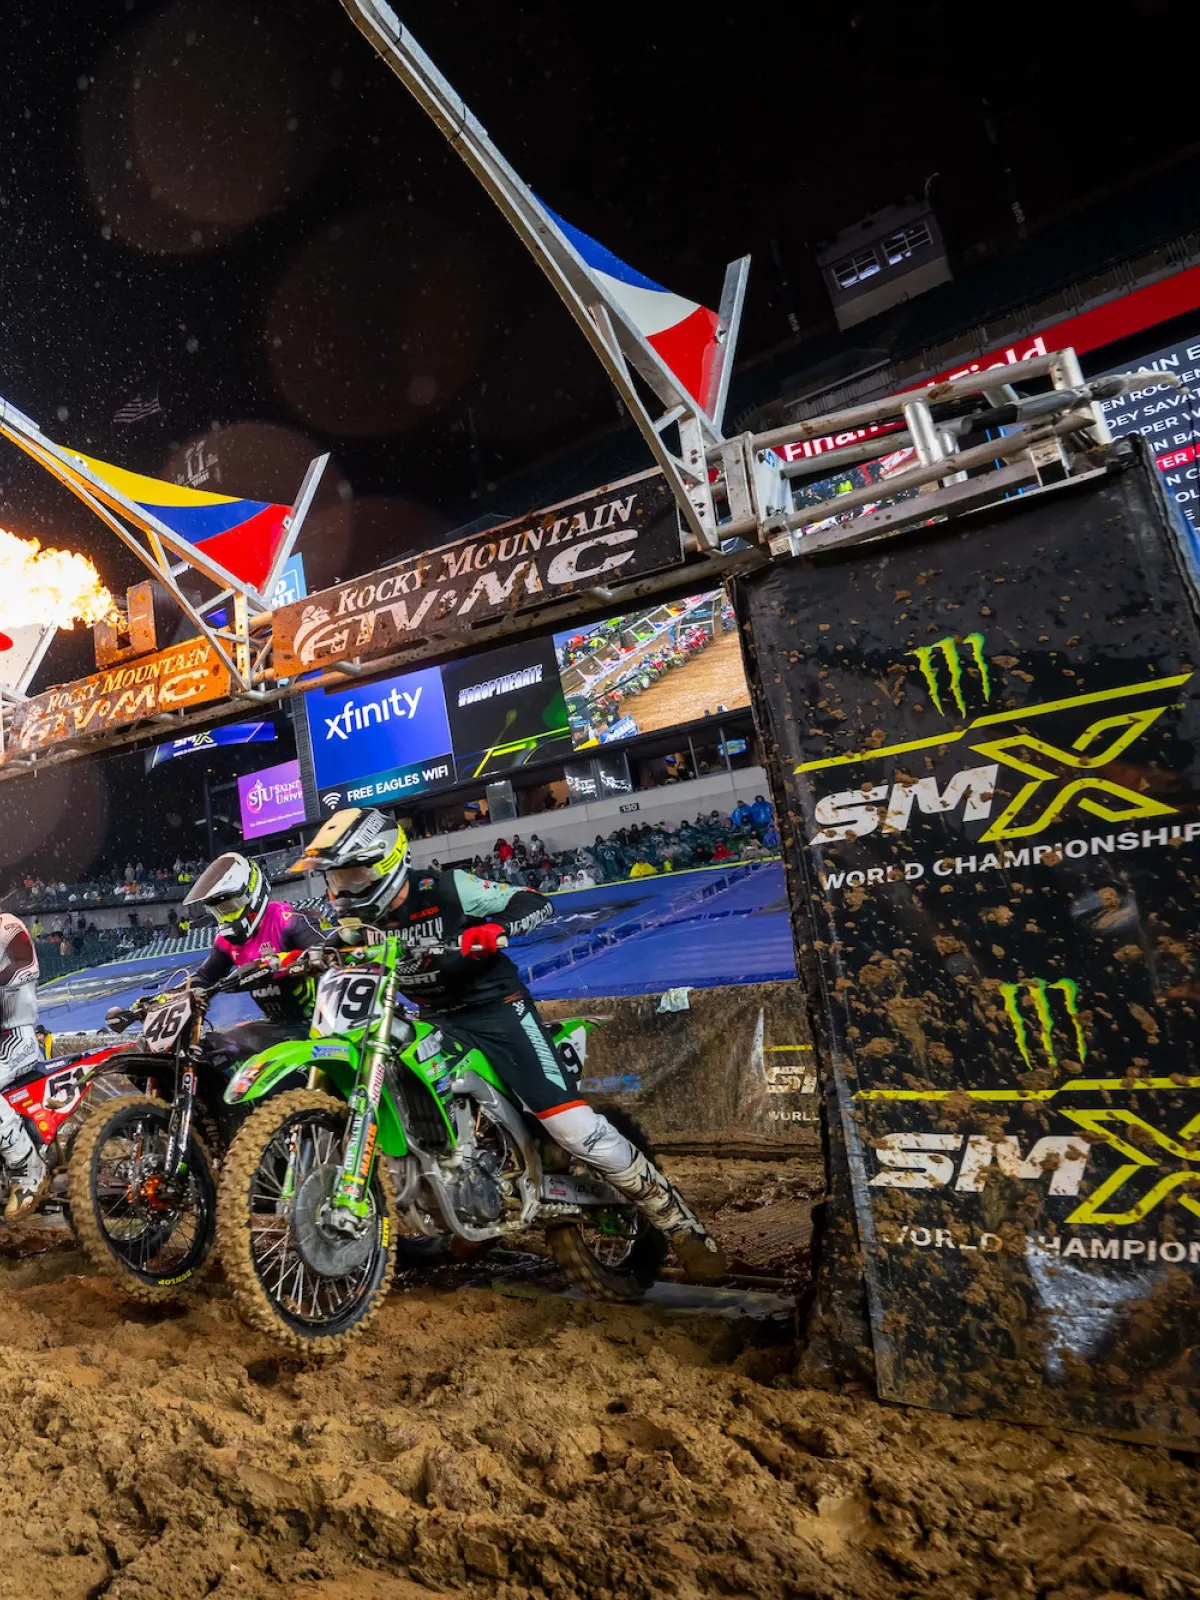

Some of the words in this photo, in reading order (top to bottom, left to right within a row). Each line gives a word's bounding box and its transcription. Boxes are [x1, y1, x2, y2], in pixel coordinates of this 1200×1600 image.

[336, 564, 432, 617] ROCKY
[438, 494, 638, 581] MOUNTAIN
[46, 684, 100, 714] ROCKY
[99, 645, 211, 695] MOUNTAIN
[457, 664, 543, 708] #DROPTHEGATE
[324, 686, 423, 740] xfinity
[347, 785, 375, 802] FREE
[376, 773, 420, 796] EAGLES
[421, 765, 449, 784] WIFI
[809, 706, 1180, 845] SMX
[823, 861, 924, 890] WORLD
[360, 1123, 378, 1177] MAXXIS
